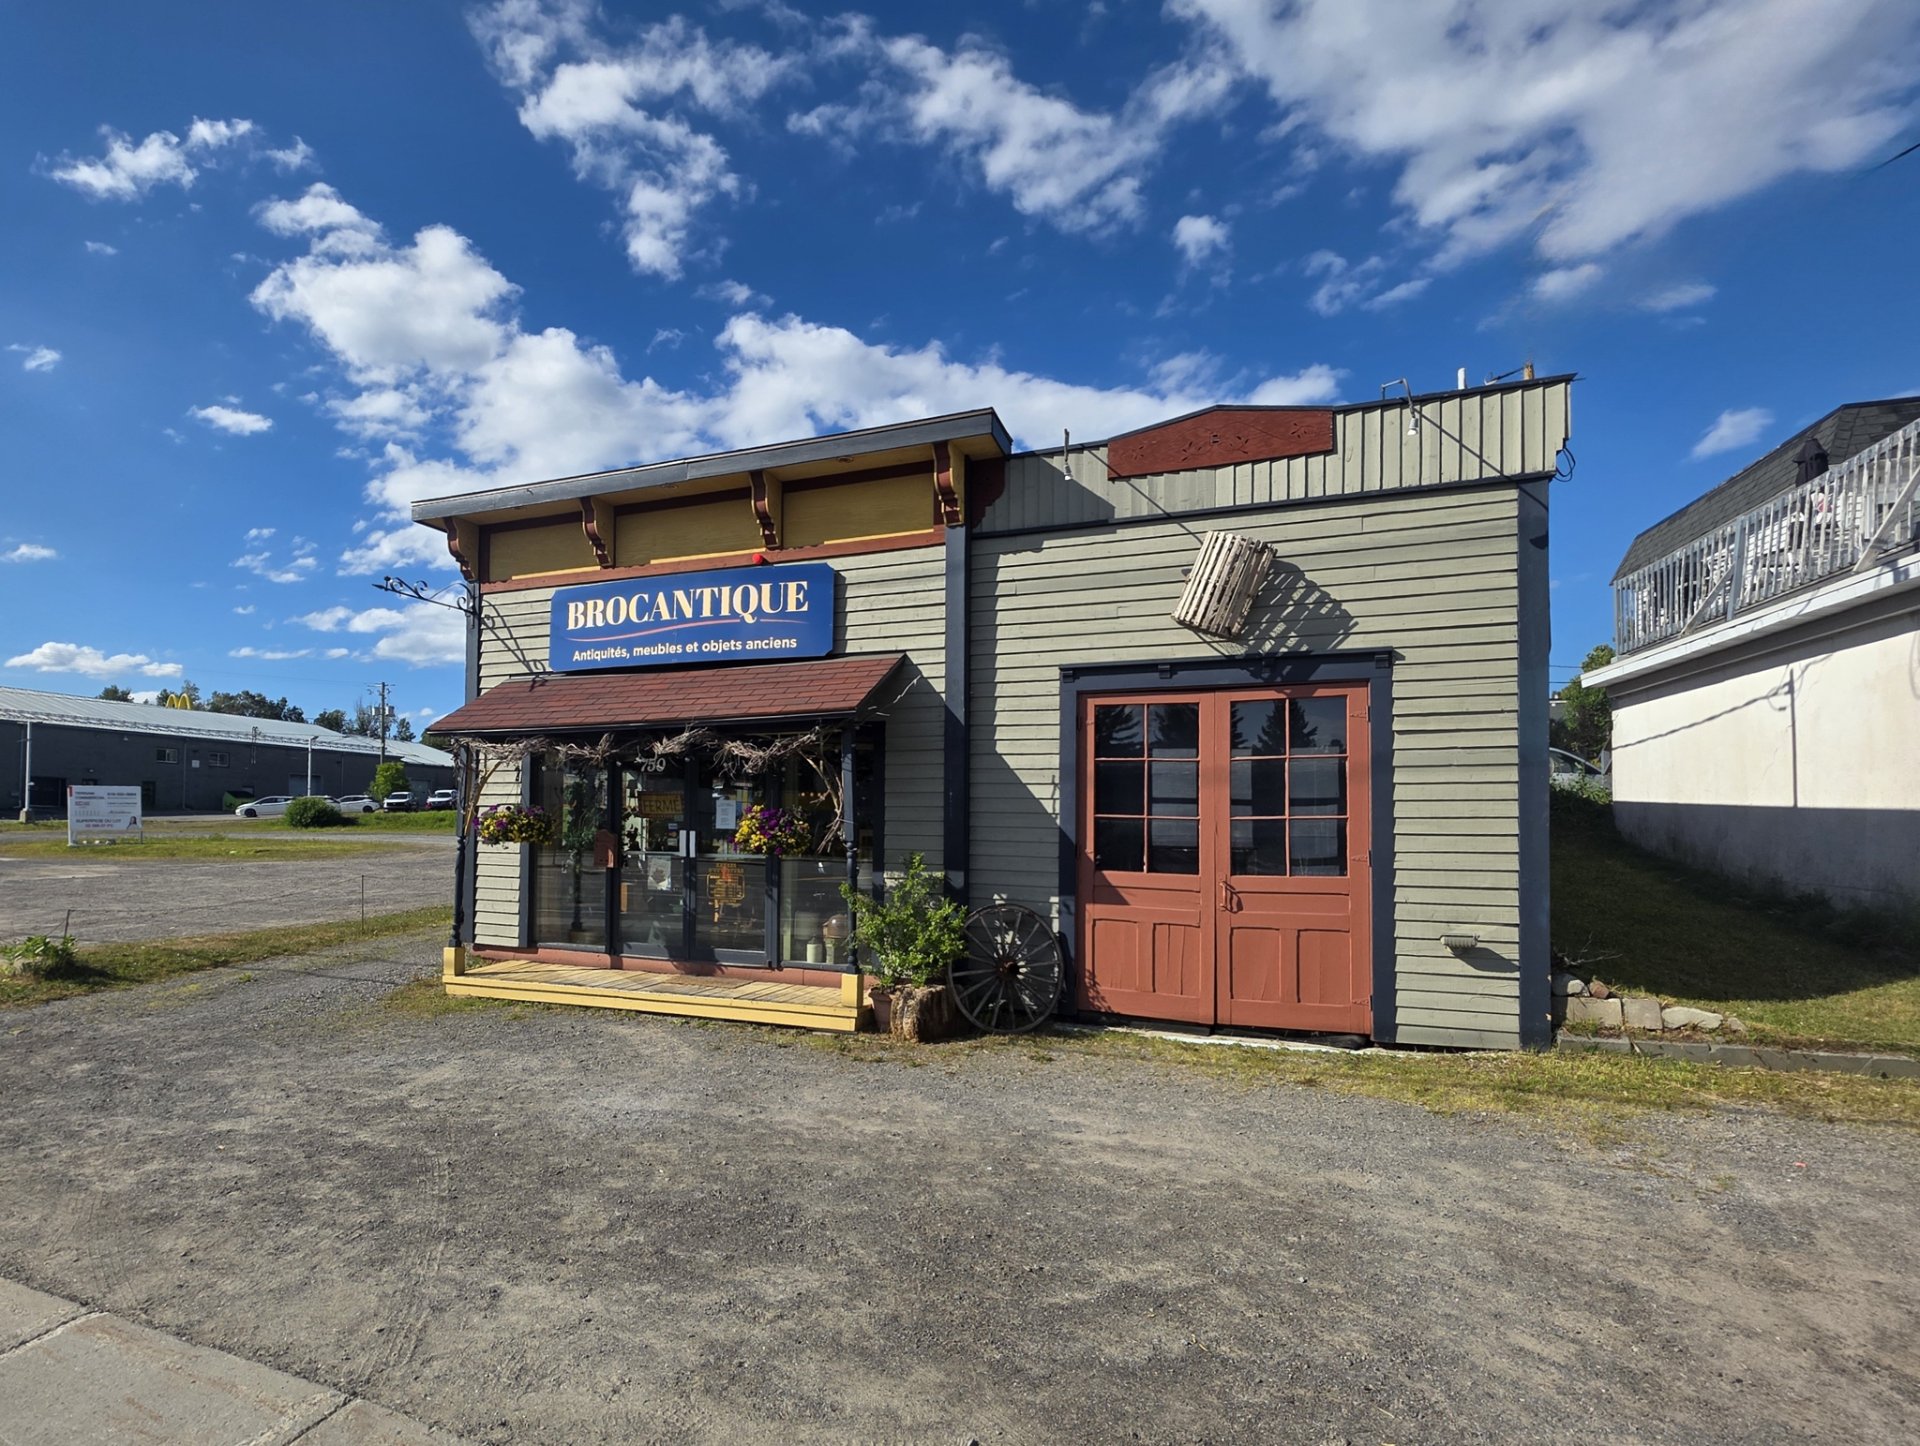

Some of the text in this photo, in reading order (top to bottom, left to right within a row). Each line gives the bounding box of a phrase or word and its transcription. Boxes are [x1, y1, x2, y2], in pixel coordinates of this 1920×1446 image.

[566, 581, 809, 631] BROCANTIQUE
[573, 636, 798, 662] Antiquités, meubles et objets anciens
[640, 757, 667, 773] 750
